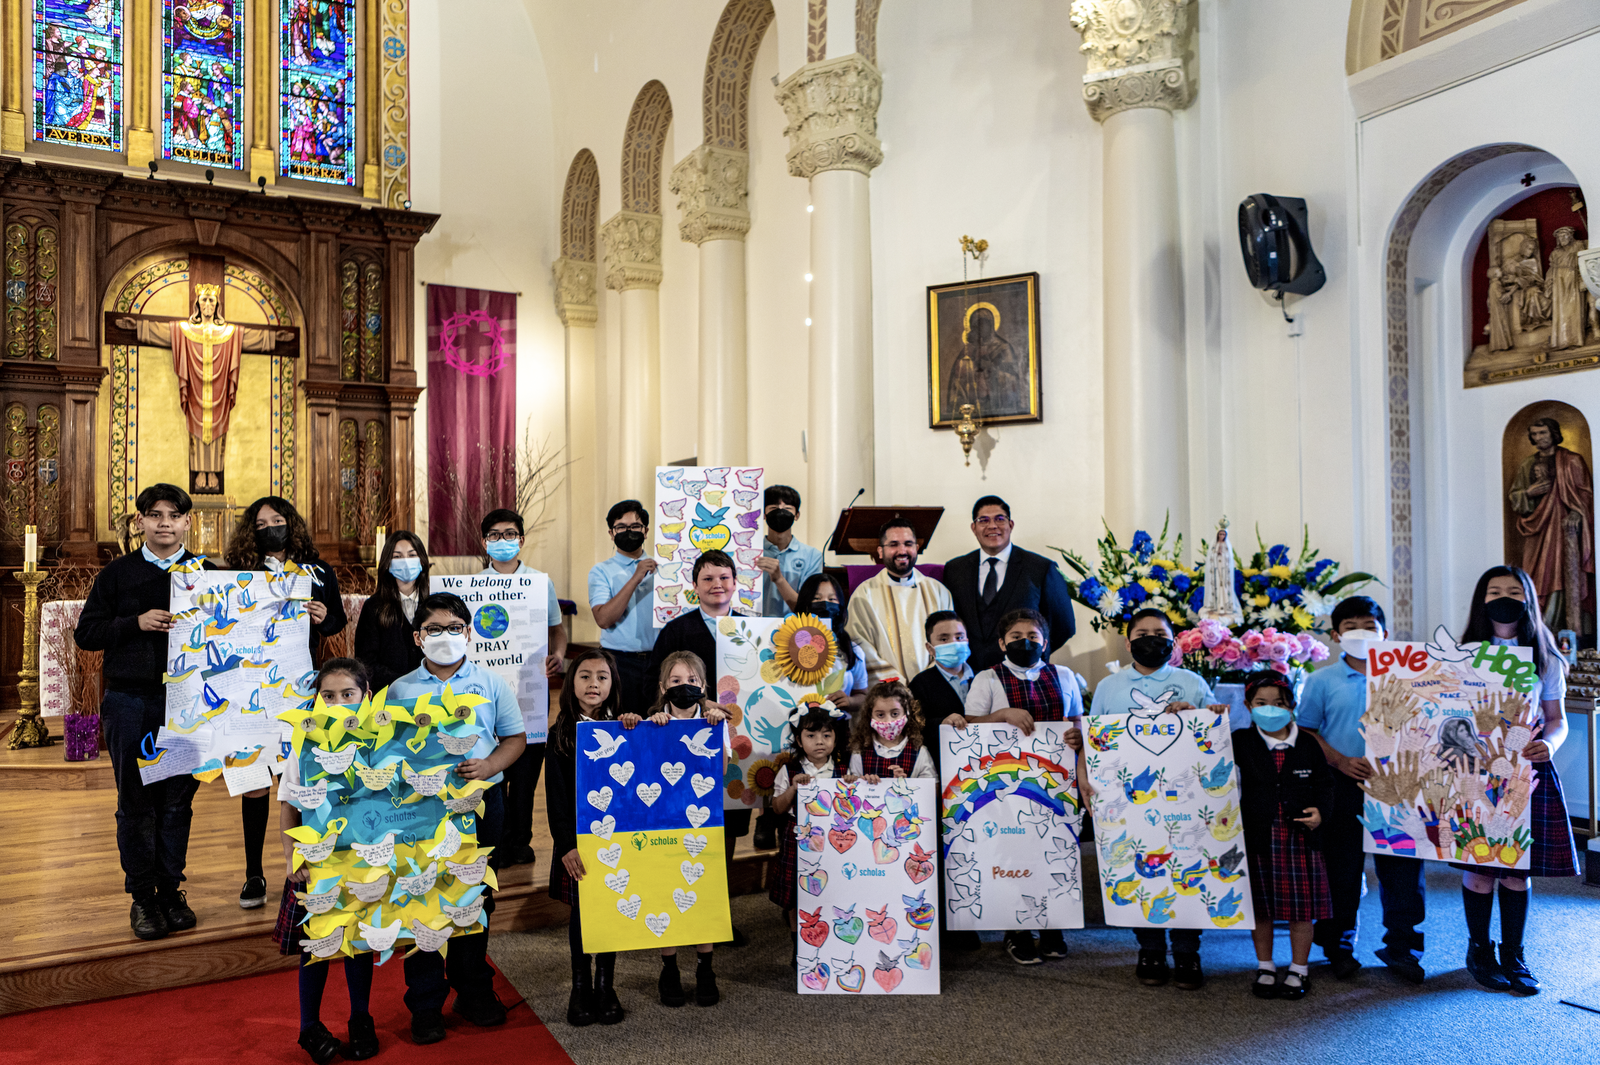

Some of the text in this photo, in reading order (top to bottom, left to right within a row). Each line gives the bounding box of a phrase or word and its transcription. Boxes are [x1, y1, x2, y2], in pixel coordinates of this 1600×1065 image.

[49, 129, 110, 146] AVE REX
[1521, 363, 1560, 373] Condemned
[442, 576, 531, 589] We belong to
[460, 590, 526, 602] ach other.
[475, 640, 510, 653] PRAY
[486, 653, 523, 667] world
[1442, 708, 1473, 717] scholas
[1135, 723, 1176, 736] PEACE
[604, 745, 616, 756] pray
[697, 747, 712, 755] peace
[384, 811, 416, 823] scholas
[1163, 813, 1192, 822] scholas
[1000, 826, 1026, 835] scholas
[650, 837, 678, 846] scholas
[859, 868, 886, 877] scholas
[992, 866, 1033, 880] Peace
